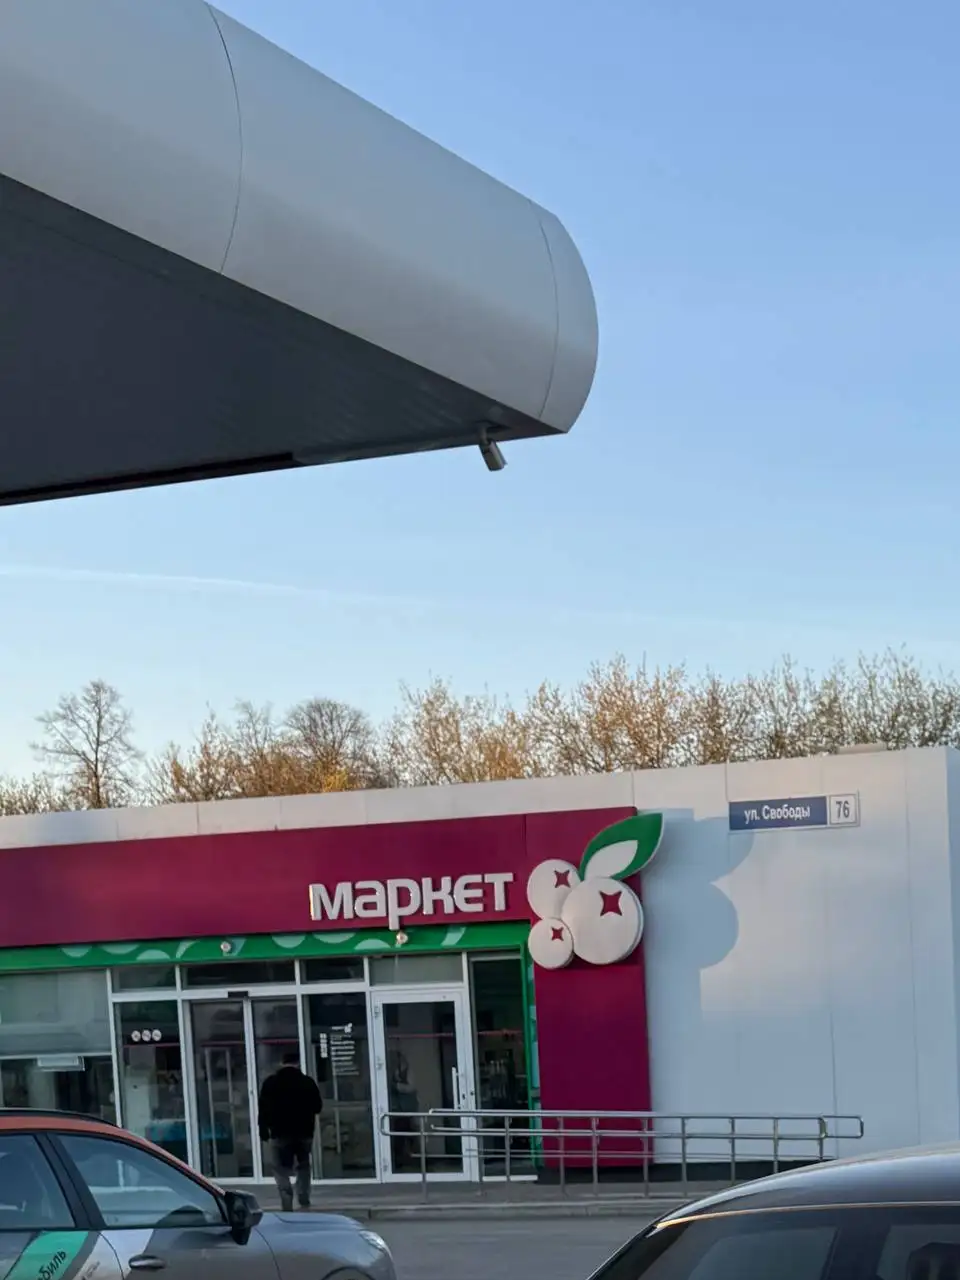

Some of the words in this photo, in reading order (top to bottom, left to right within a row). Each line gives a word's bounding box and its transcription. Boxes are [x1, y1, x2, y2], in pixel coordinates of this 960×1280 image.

[744, 808, 760, 825] ул.
[761, 804, 811, 821] Свободы
[835, 800, 850, 818] 76
